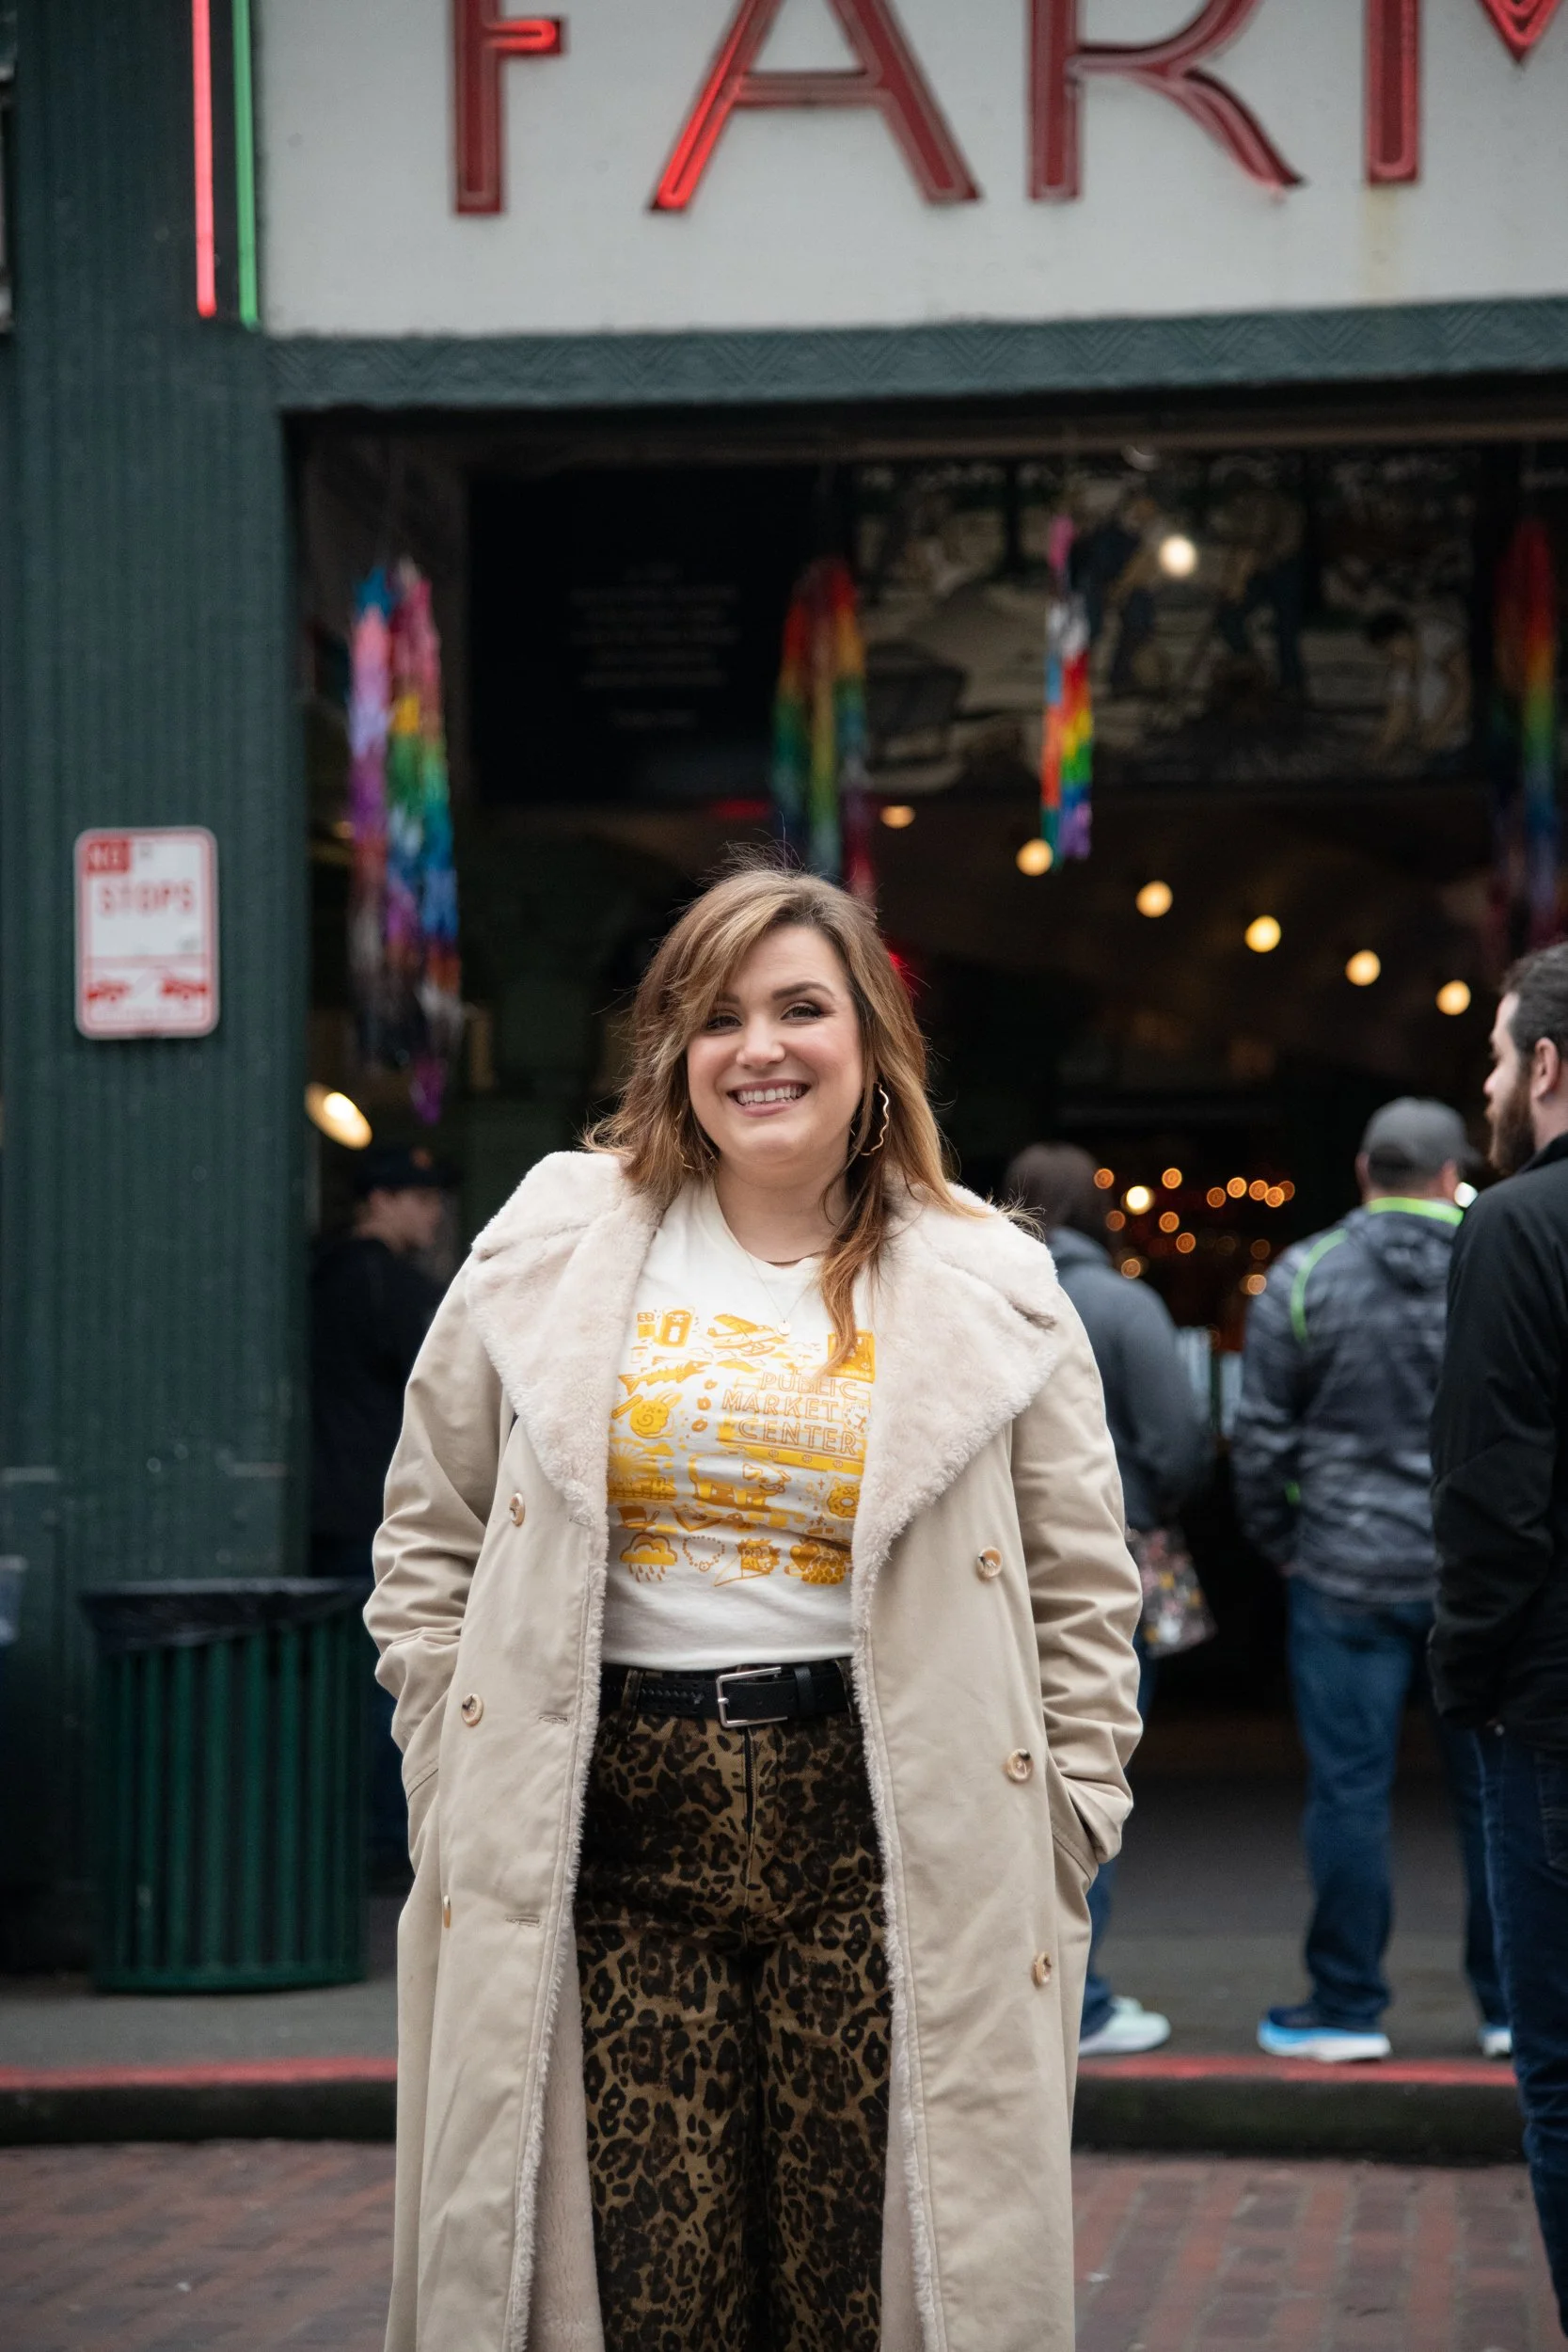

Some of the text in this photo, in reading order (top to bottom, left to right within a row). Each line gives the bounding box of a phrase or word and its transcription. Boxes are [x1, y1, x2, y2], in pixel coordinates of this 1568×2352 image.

[760, 1372, 858, 1401] PUBLIC
[721, 1389, 839, 1422] MARKET
[738, 1418, 857, 1456] CENTER
